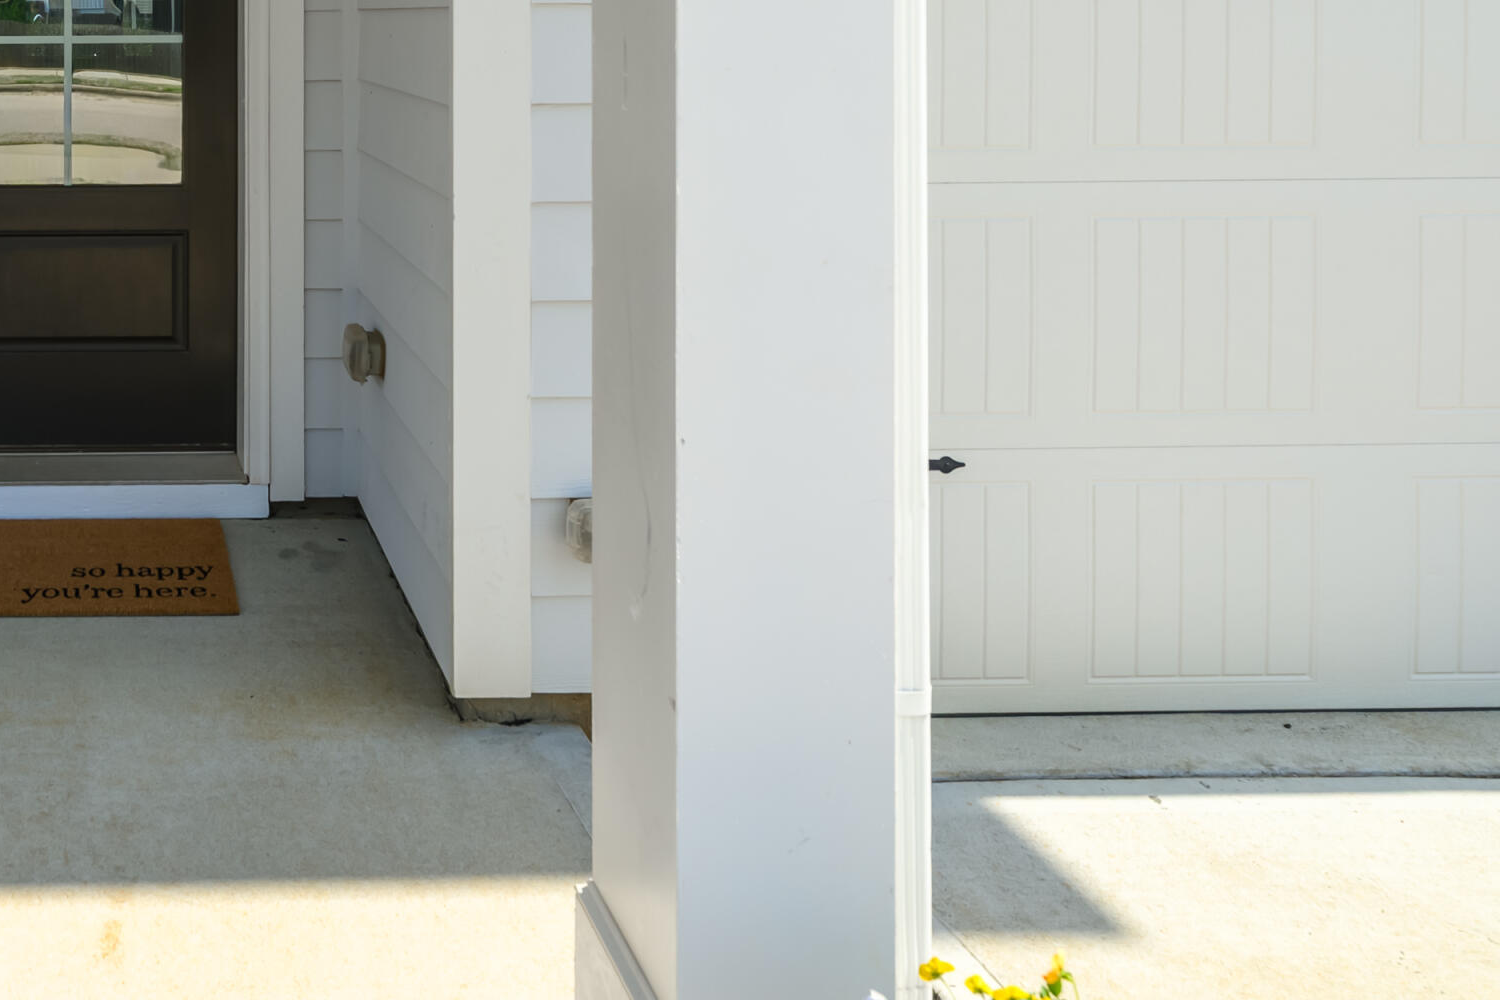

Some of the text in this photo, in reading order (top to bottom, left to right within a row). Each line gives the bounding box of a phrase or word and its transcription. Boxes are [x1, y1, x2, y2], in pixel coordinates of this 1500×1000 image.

[71, 563, 214, 580] so happy
[21, 583, 217, 604] you're here.
